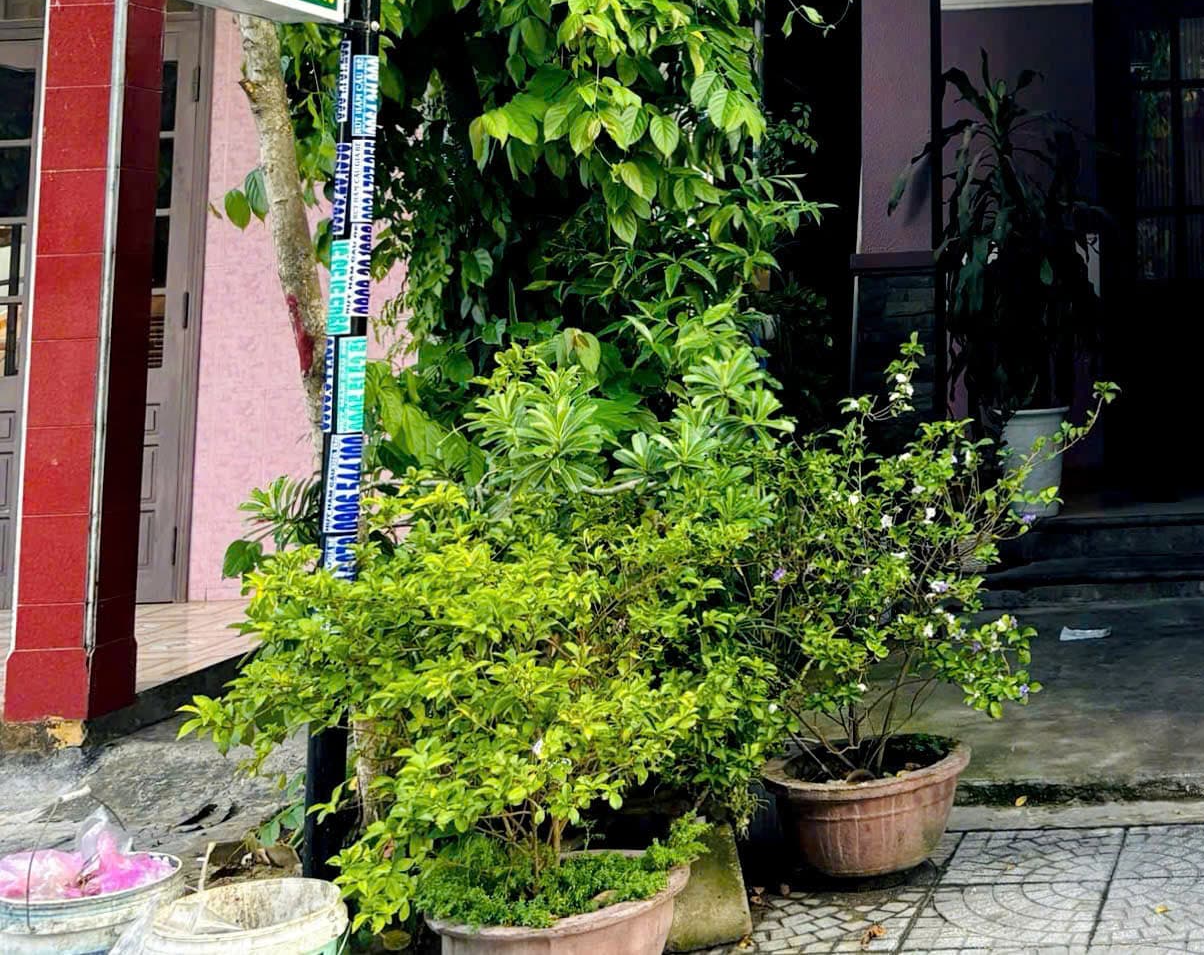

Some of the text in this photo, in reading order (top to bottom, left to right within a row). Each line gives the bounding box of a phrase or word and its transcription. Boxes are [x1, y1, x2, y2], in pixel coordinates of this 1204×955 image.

[340, 436, 363, 459] 100
[335, 463, 361, 491] 544
[331, 494, 360, 531] 0906
